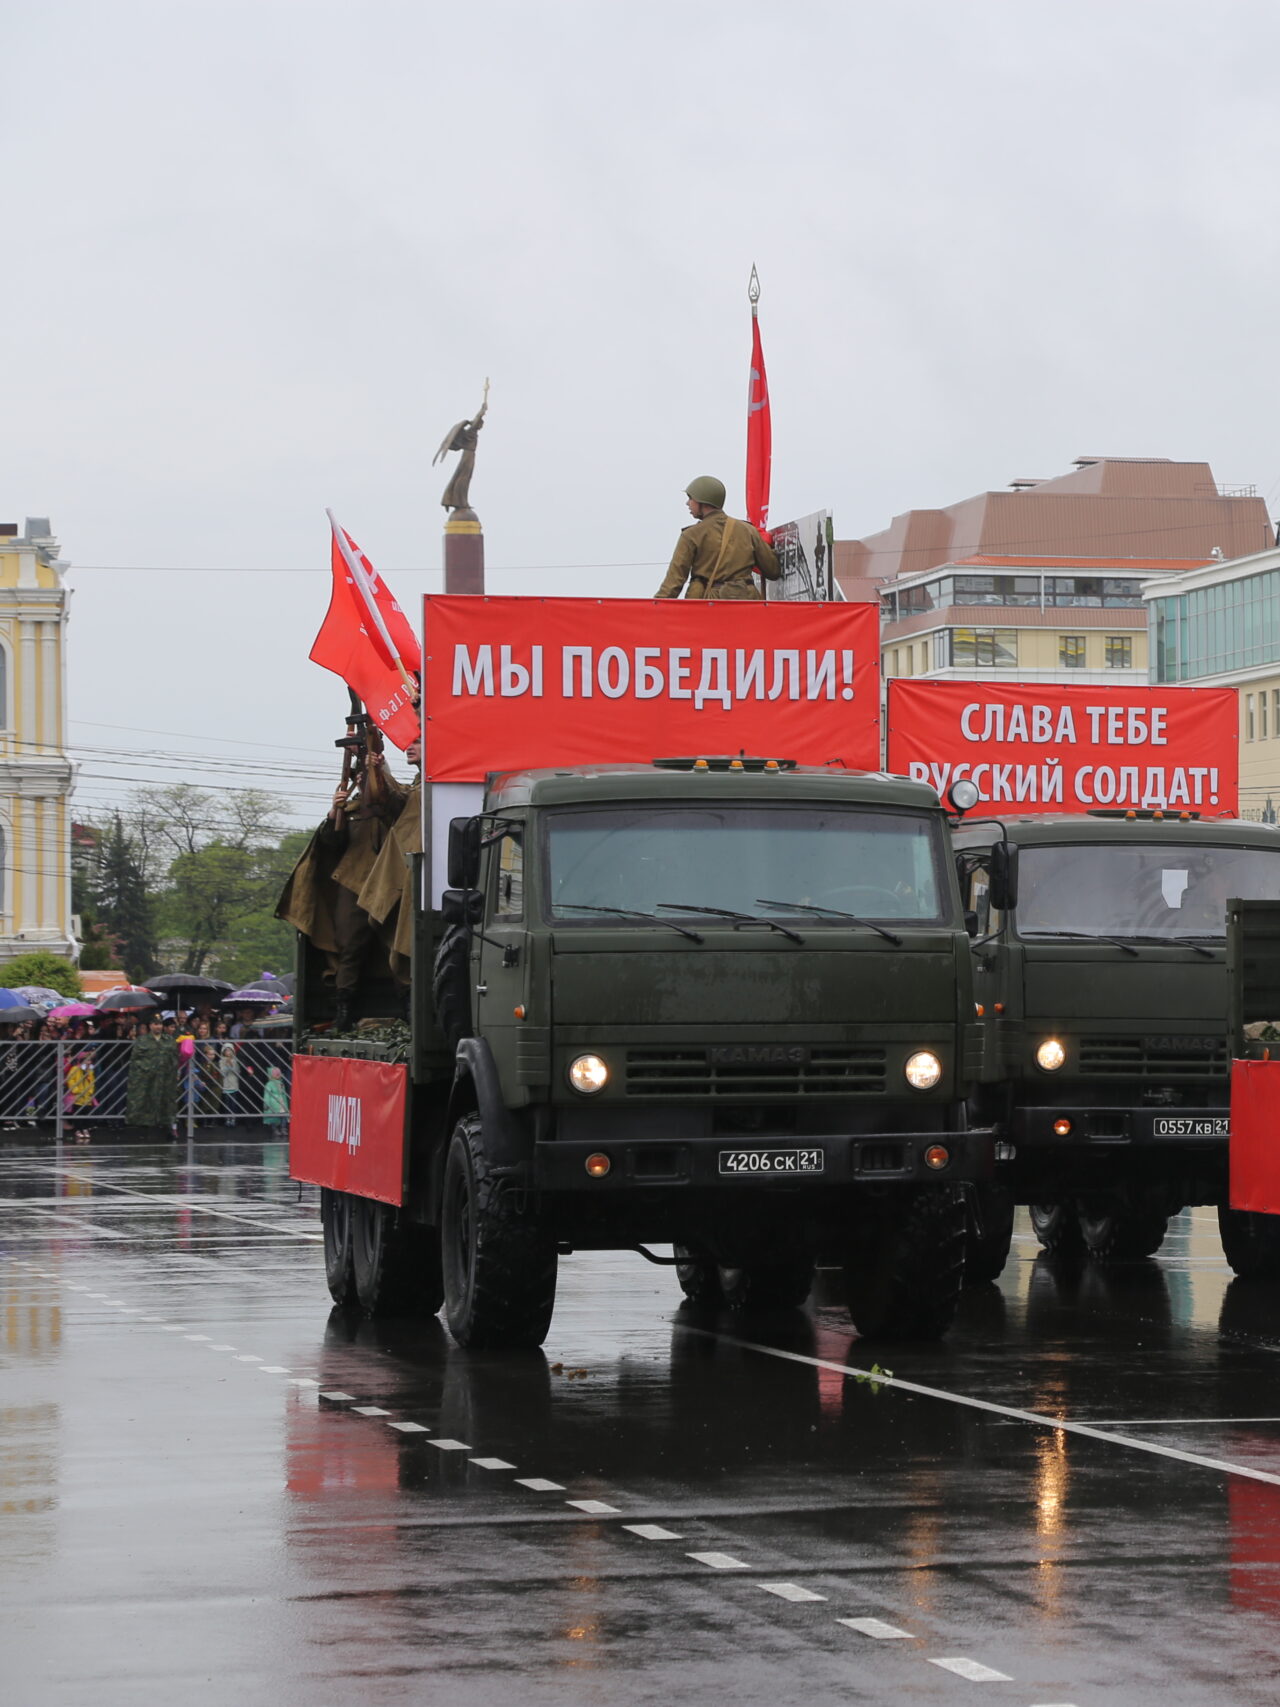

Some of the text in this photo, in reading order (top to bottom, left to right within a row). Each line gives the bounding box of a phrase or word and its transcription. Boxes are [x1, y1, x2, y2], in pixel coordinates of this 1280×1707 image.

[451, 643, 854, 710] МЫ ПОБЕДИЛИ!
[960, 702, 1168, 745] СЛАВА ТЕБЕ
[1074, 765, 1219, 811] СОЛДАТ!
[726, 1153, 771, 1171] 4206
[800, 1151, 818, 1165] 21
